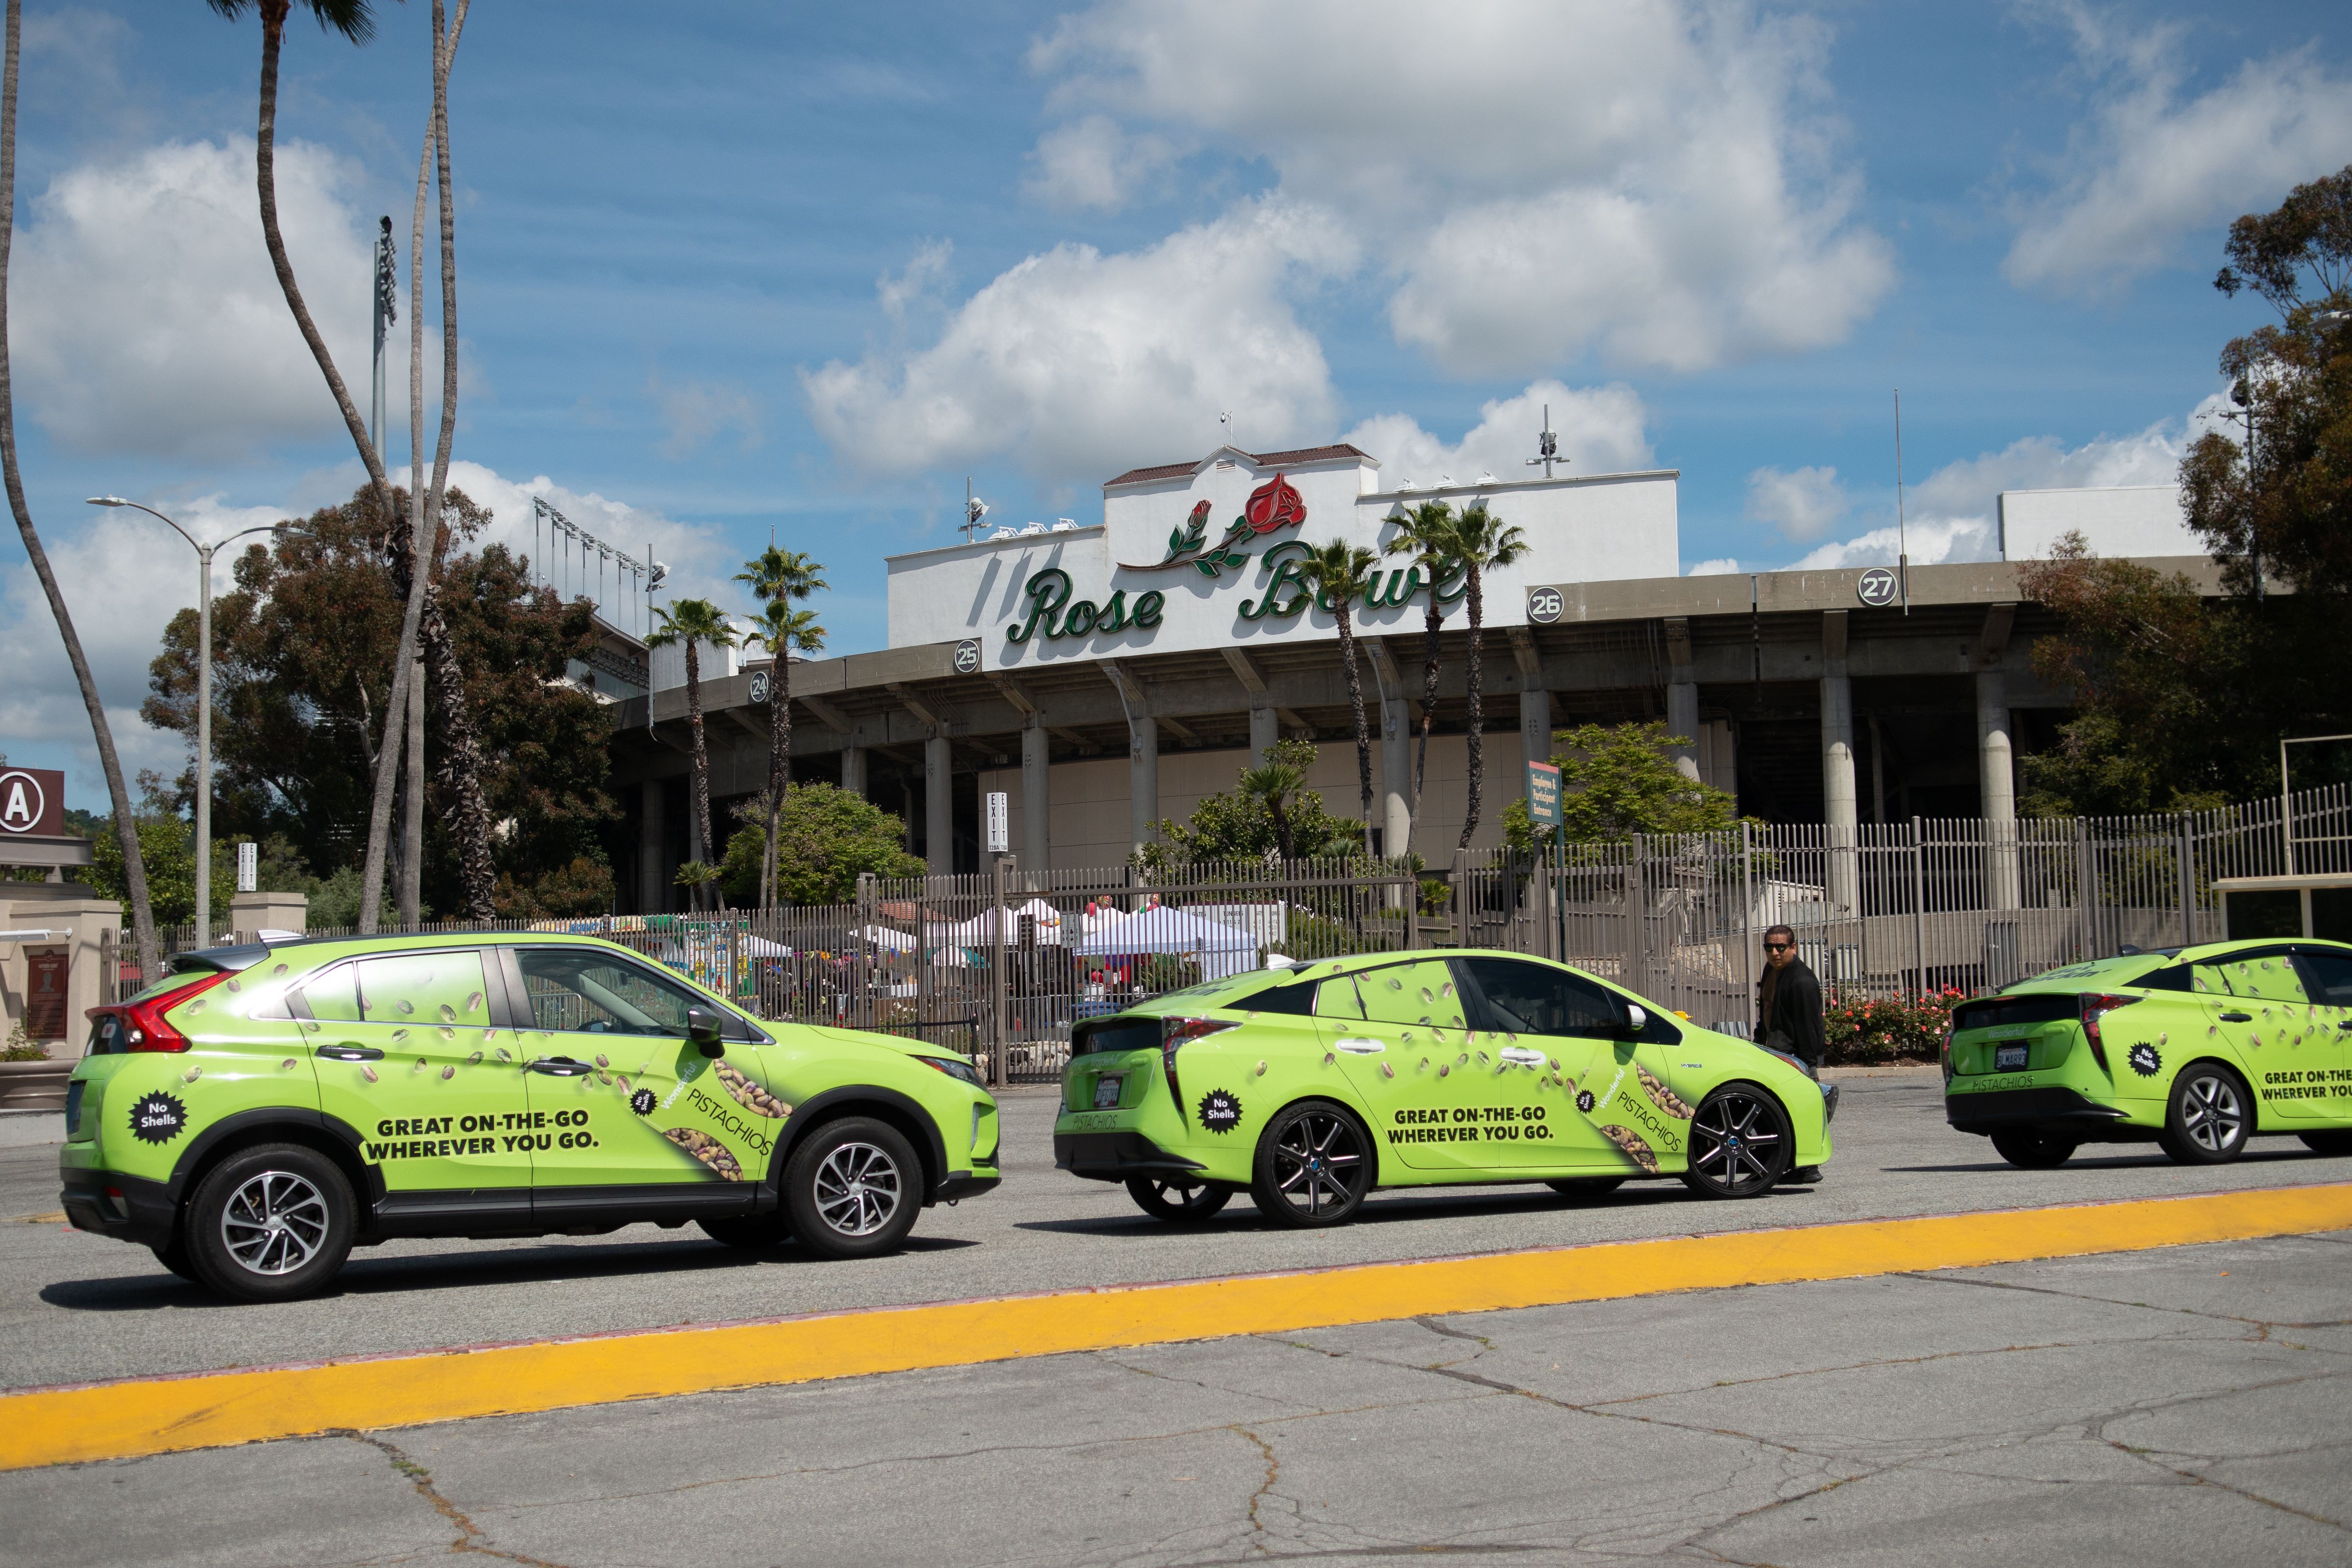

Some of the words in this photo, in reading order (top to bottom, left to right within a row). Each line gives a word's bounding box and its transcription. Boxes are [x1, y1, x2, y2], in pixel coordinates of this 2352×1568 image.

[1863, 577, 1893, 597] 27
[1005, 568, 1165, 644] Rose
[1532, 595, 1560, 615] 26
[957, 647, 977, 665] 25
[753, 678, 766, 695] 24
[1532, 773, 1552, 790] Employee
[5, 782, 29, 821] A
[1533, 788, 1555, 805] Participant
[1988, 1027, 2026, 1038] Wonderful
[2135, 1054, 2156, 1069] Shells
[2141, 1048, 2153, 1058] No
[660, 1060, 697, 1110] Wonderful
[1973, 1076, 2034, 1092] PISTACHIOS
[2265, 1072, 2303, 1084] GREAT
[1598, 1067, 1625, 1109] Wonderful
[2261, 1086, 2327, 1100] WHEREVER
[149, 1103, 168, 1113] No
[635, 1097, 642, 1105] No
[641, 1094, 650, 1111] Shells
[1214, 1099, 1228, 1108] No
[141, 1114, 177, 1127] Shells
[686, 1088, 773, 1156] PISTACHIOS
[1073, 1115, 1118, 1129] PISTACHIOS
[1208, 1109, 1235, 1119] Shells
[1395, 1109, 1448, 1124] GREAT
[1453, 1106, 1545, 1123] ON-THE-GO
[1617, 1091, 1681, 1151] PISTACHIOS
[377, 1117, 453, 1136] GREAT
[460, 1110, 588, 1132] ON-THE-GO
[1387, 1127, 1478, 1144] WHEREVER
[1483, 1126, 1519, 1141] YOU
[1524, 1125, 1553, 1139] GO.
[366, 1138, 495, 1160] WHEREVER
[501, 1134, 552, 1152] YOU
[558, 1131, 599, 1149] GO.
